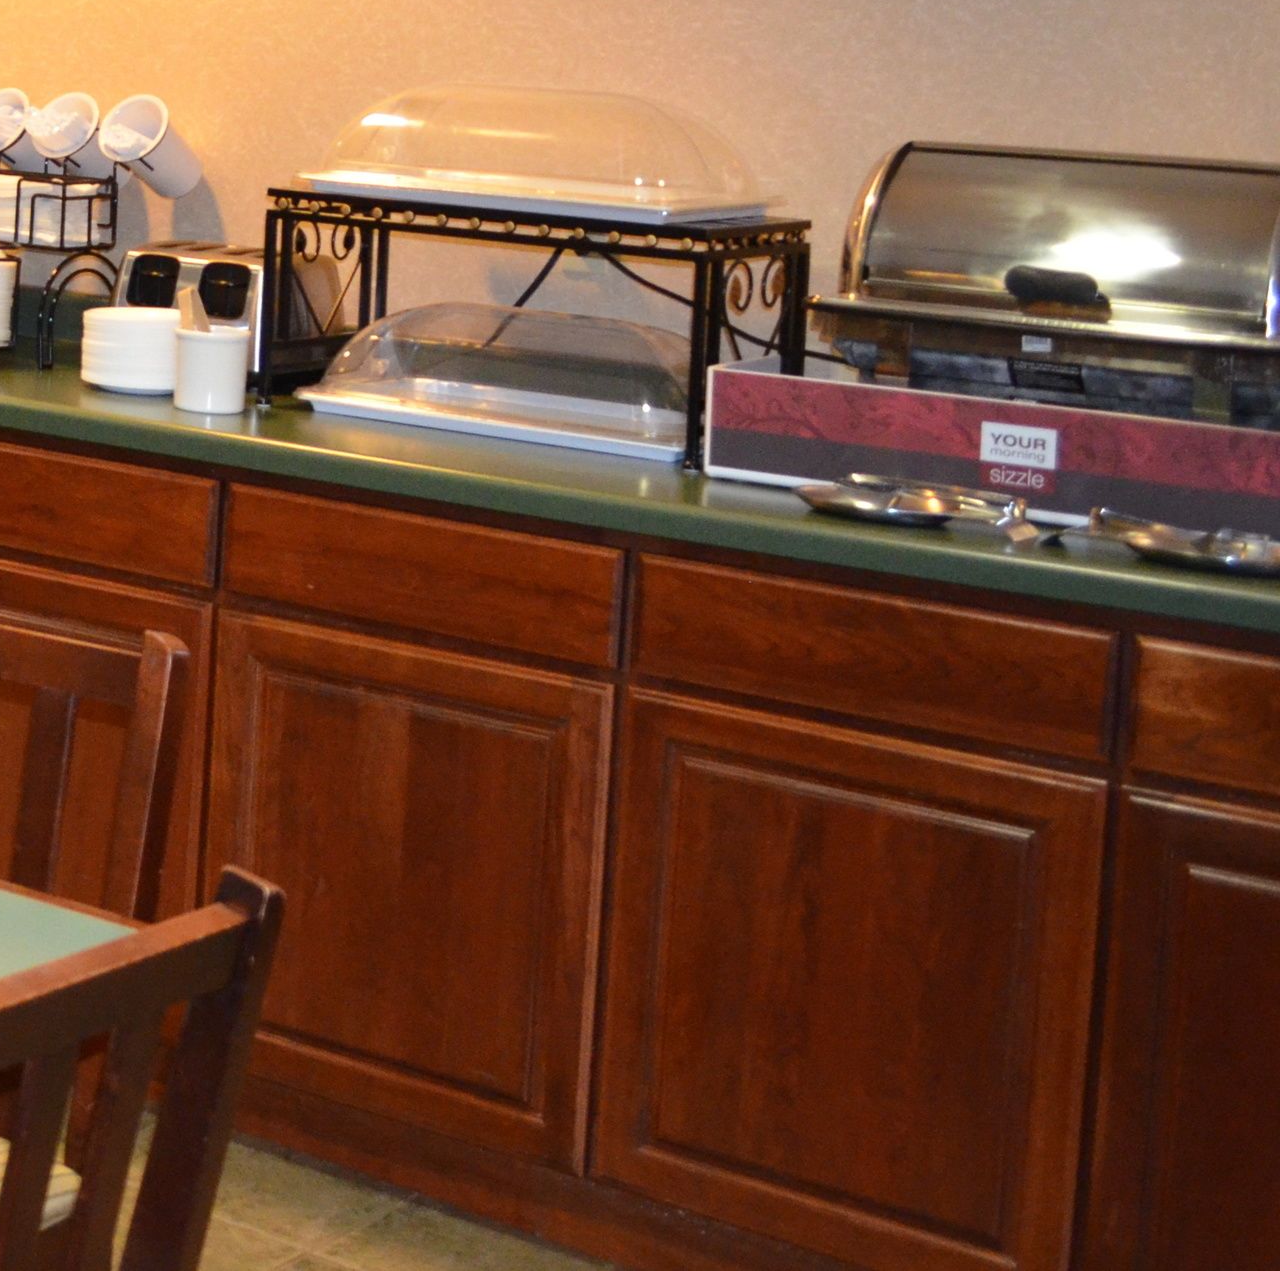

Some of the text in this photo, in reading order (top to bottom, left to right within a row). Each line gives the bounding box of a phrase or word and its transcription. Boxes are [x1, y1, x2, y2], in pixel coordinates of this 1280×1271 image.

[991, 432, 1046, 450] YOUR
[990, 448, 1046, 463] morning
[990, 465, 1044, 488] sizzle
